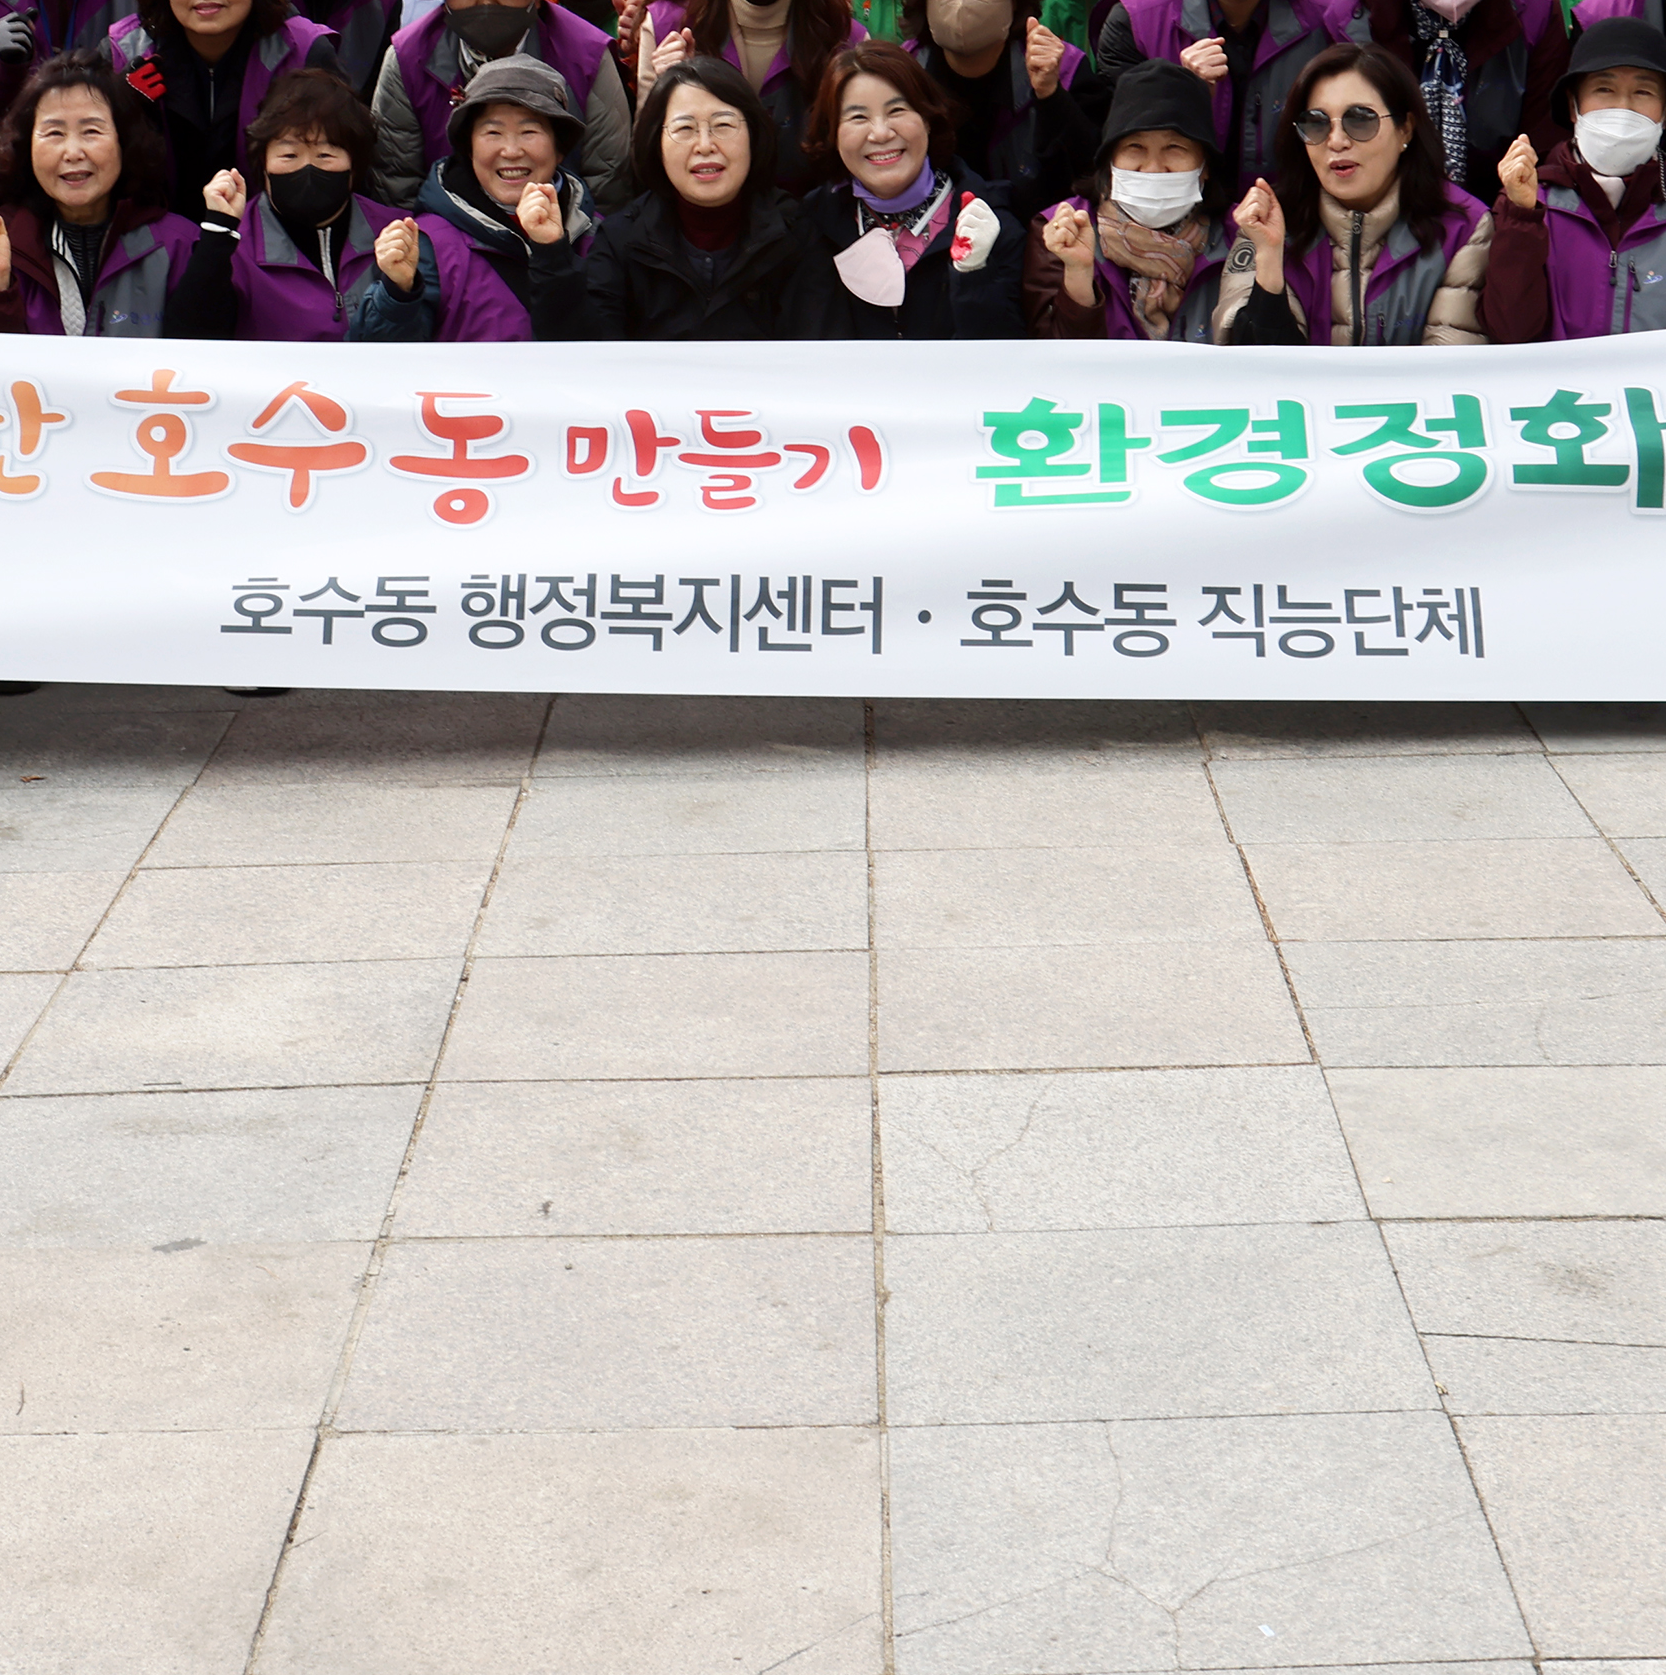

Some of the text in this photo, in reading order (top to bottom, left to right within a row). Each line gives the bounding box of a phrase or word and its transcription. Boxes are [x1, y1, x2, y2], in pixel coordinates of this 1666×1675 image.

[88, 367, 533, 527] 호수동
[564, 408, 885, 512] 만들기
[219, 571, 1487, 660] 호수동 행정복지센터 호수동 직능단체
